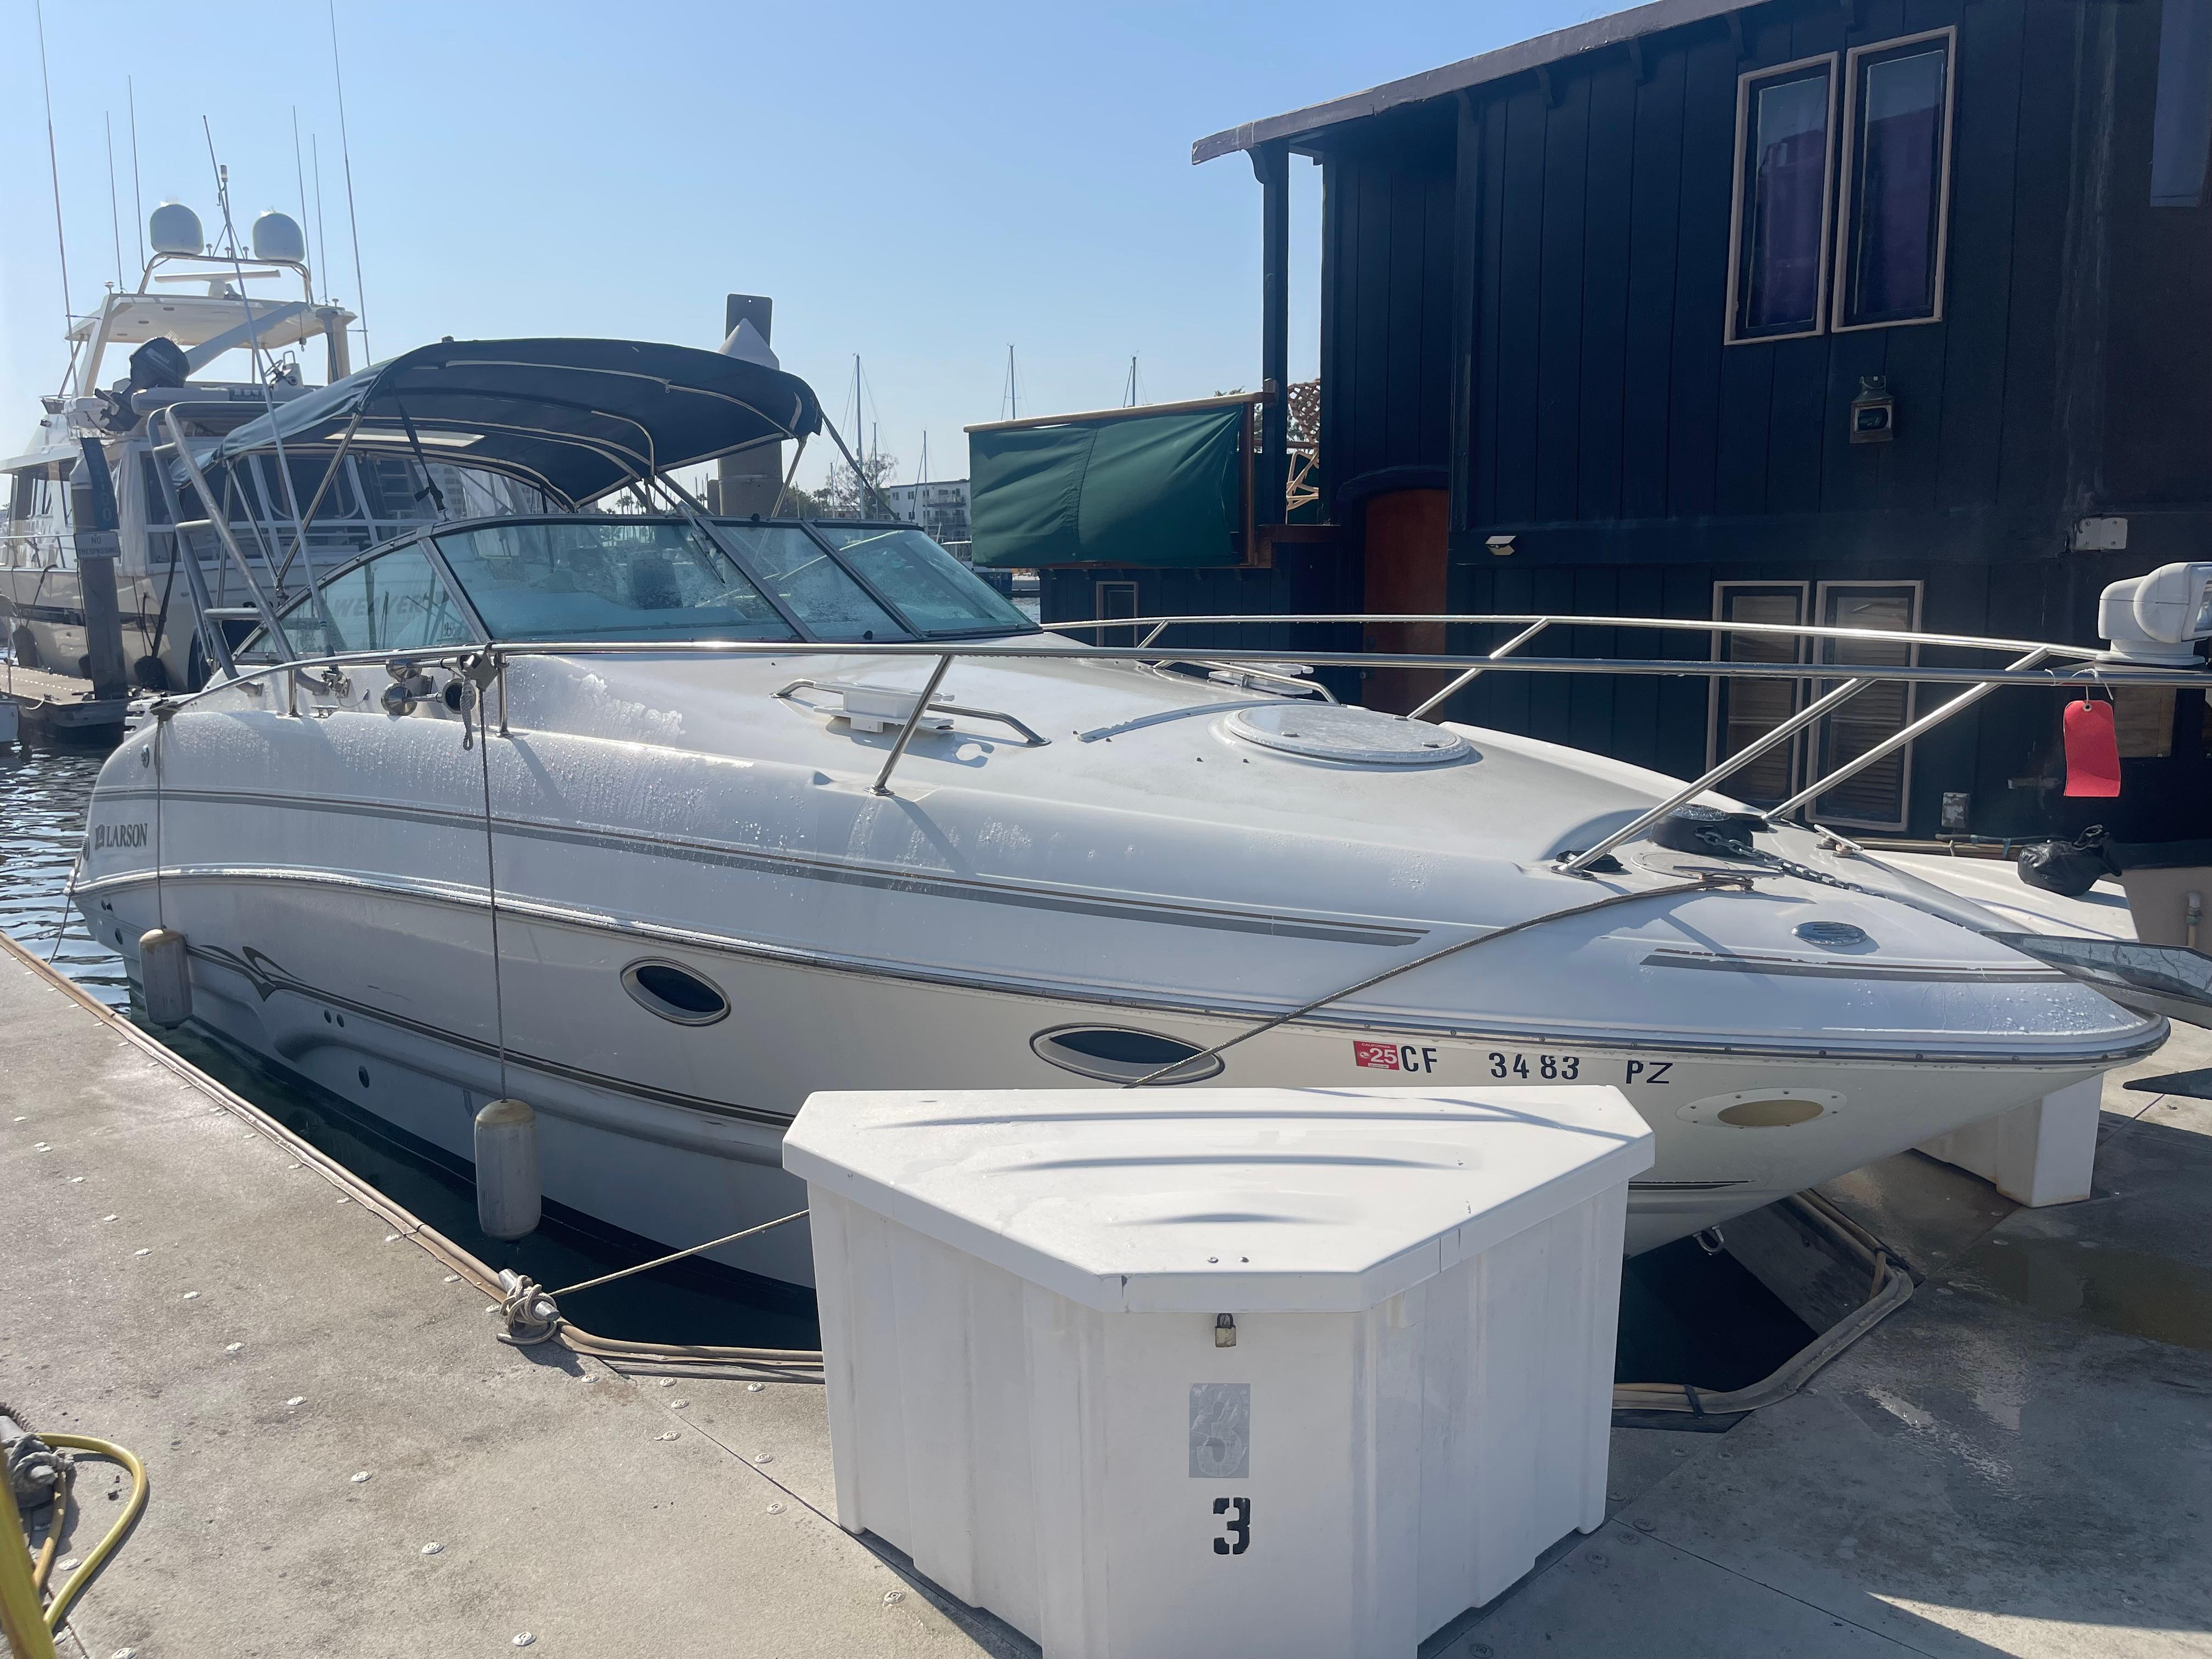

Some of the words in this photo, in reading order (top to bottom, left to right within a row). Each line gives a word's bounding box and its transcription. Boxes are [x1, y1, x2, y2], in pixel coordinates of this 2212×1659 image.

[91, 536, 101, 544] NO
[78, 547, 119, 555] TRESPASSING
[106, 823, 148, 848] LARSON
[1369, 1047, 1398, 1064] 25
[1401, 1045, 1438, 1074] CF
[1488, 1052, 1580, 1080] 3483
[1626, 1060, 1674, 1085] PZ
[1212, 1497, 1251, 1555] 3
